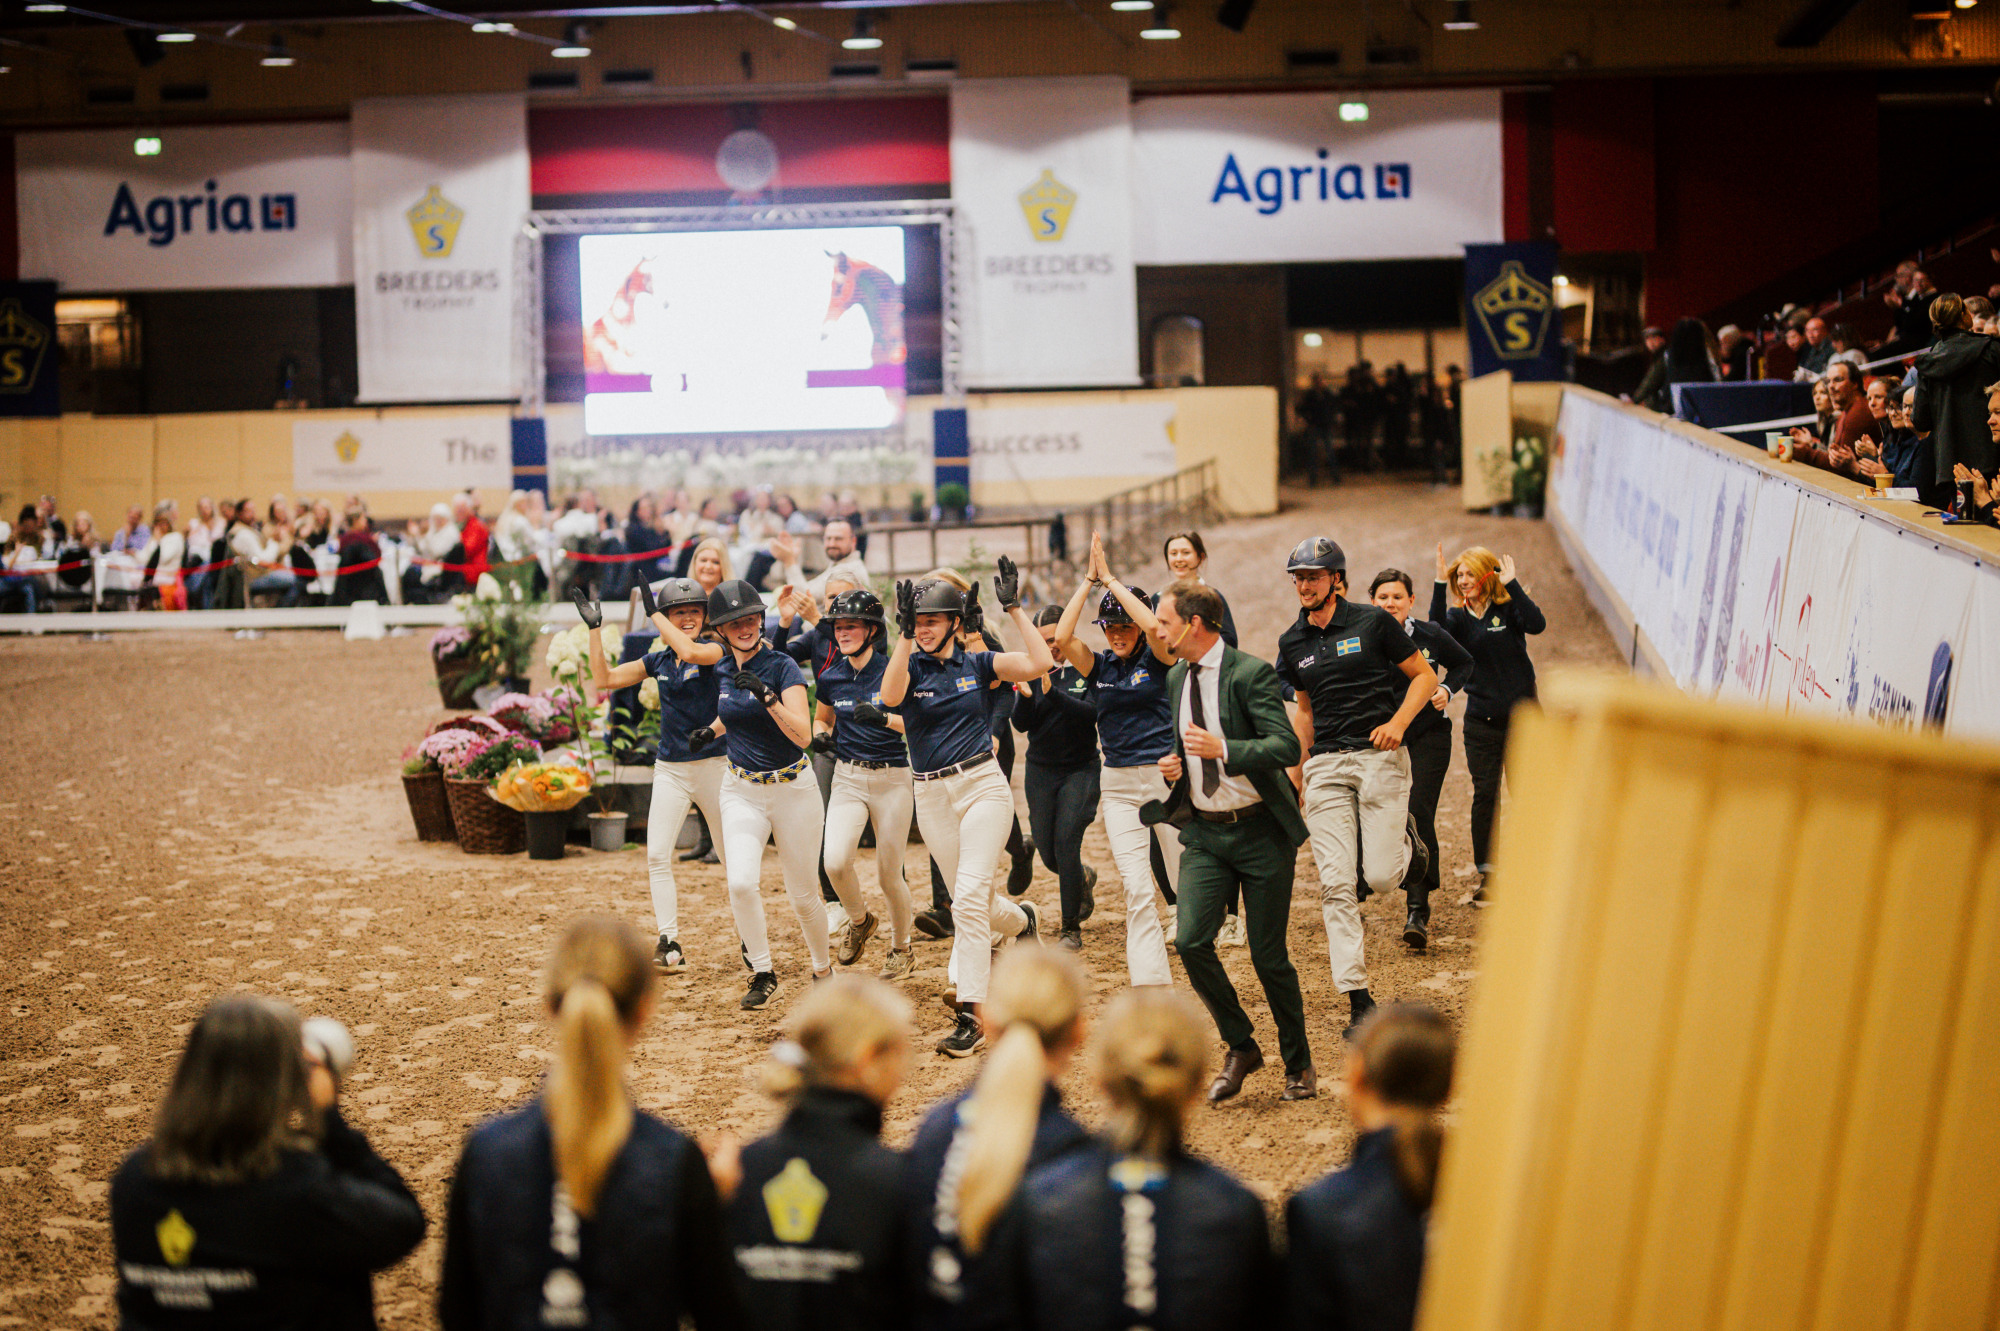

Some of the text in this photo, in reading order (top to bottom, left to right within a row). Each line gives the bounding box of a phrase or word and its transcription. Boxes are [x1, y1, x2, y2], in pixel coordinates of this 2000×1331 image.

[1210, 147, 1366, 215] Agria
[103, 178, 254, 247] Agria
[1039, 208, 1057, 235] S
[427, 224, 445, 252] S
[985, 254, 1115, 277] BREEDERS
[375, 269, 499, 293] BREEDERS
[1504, 311, 1531, 350] S
[1, 349, 25, 385] S
[441, 436, 499, 465] The
